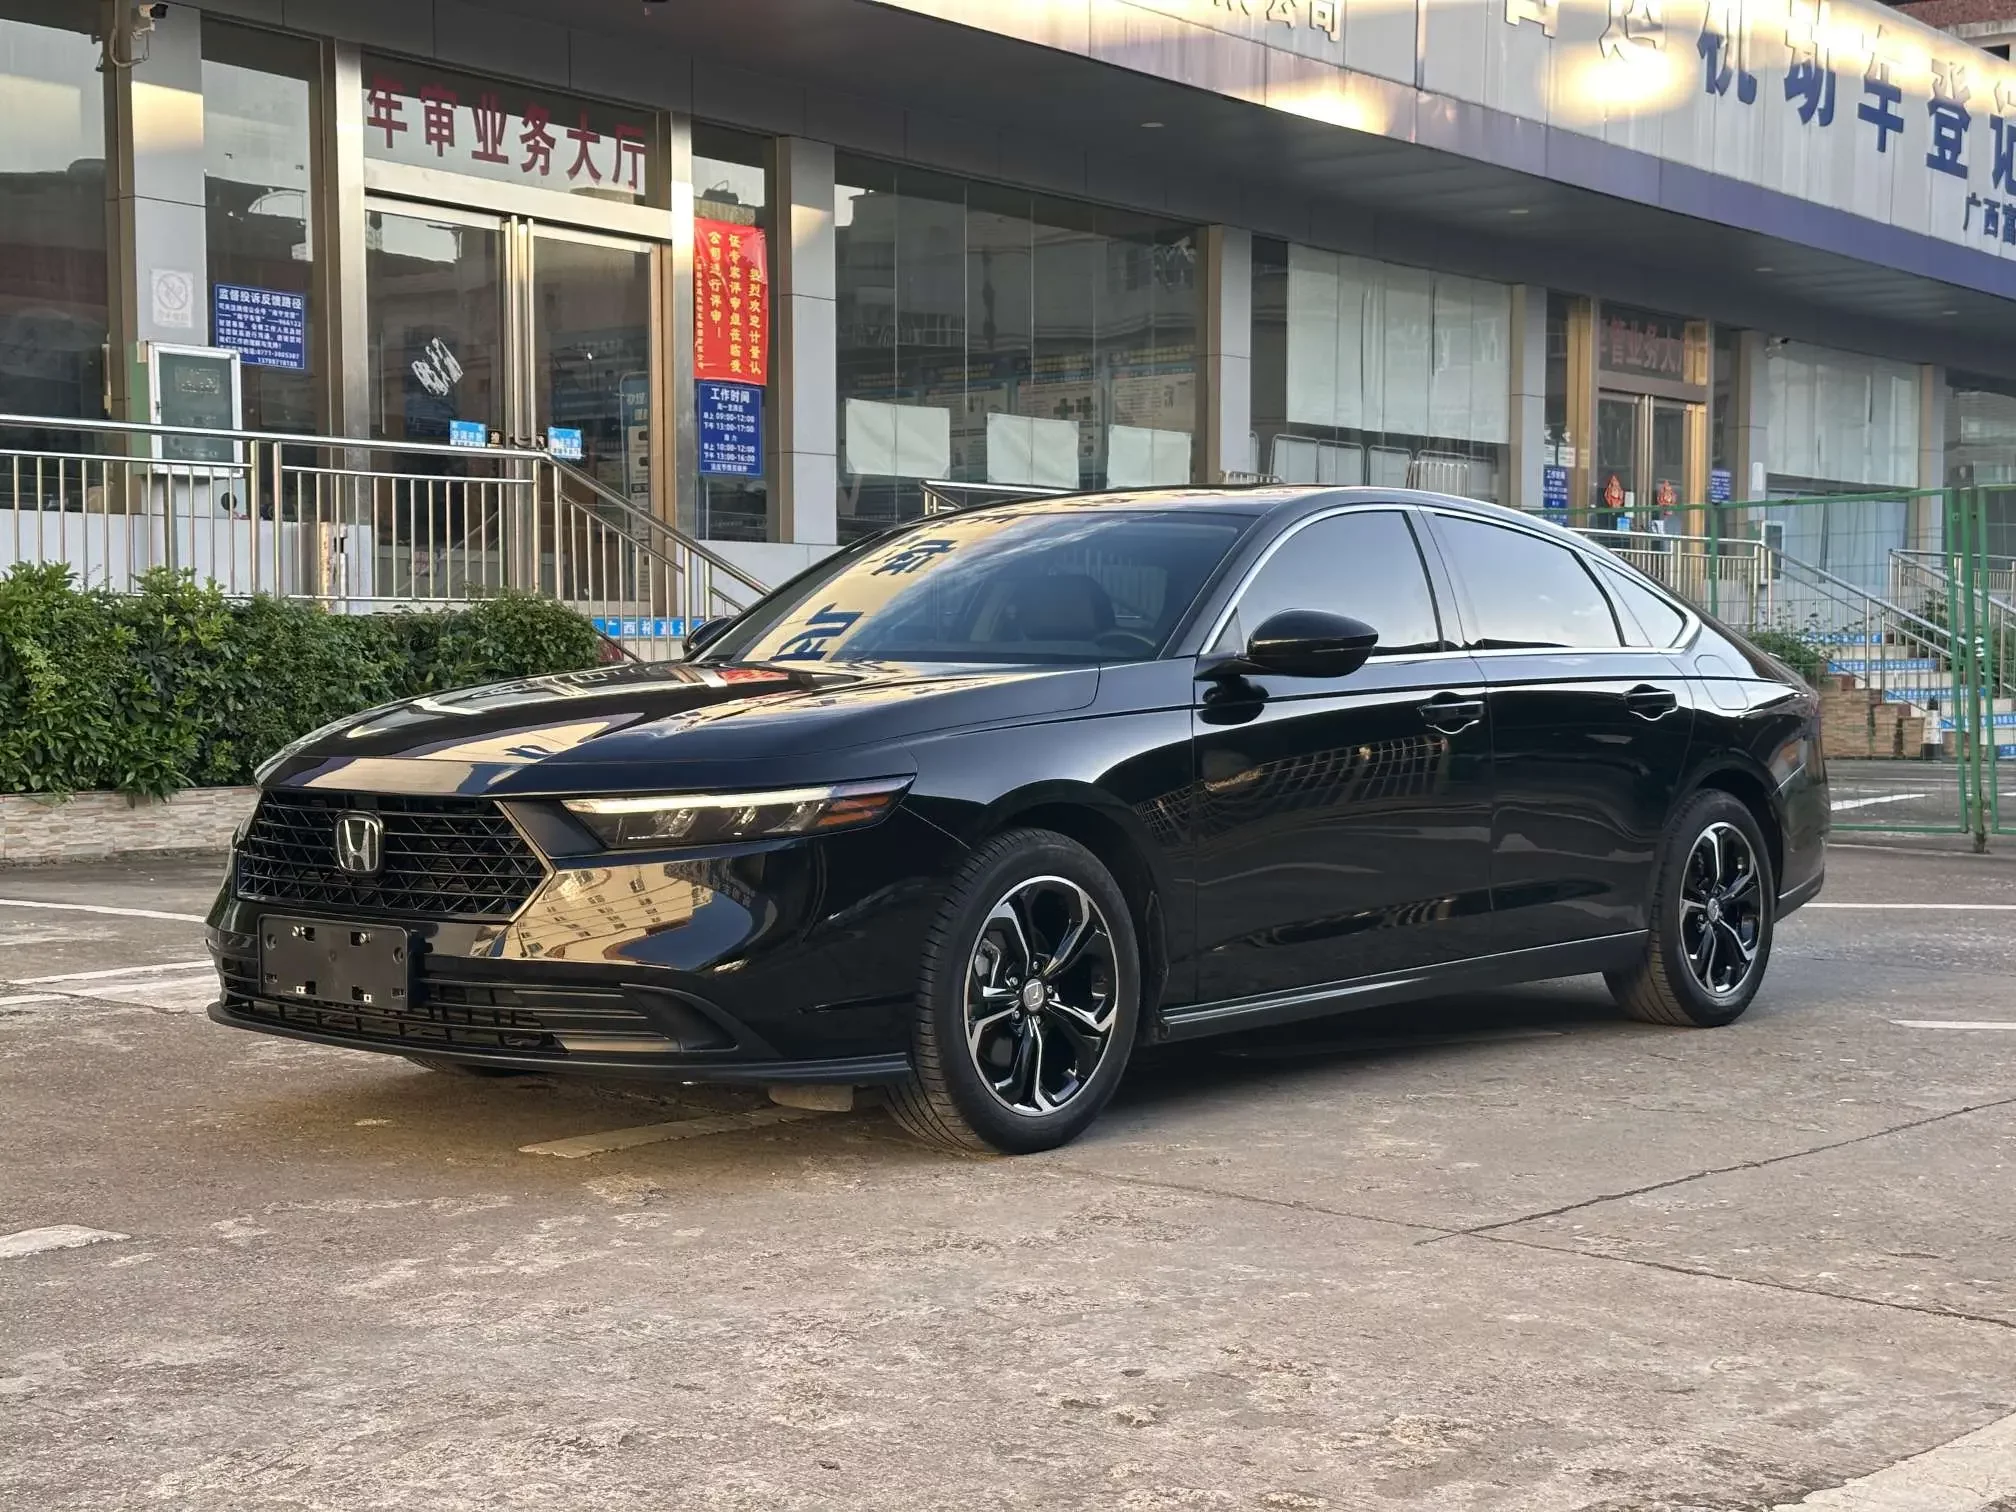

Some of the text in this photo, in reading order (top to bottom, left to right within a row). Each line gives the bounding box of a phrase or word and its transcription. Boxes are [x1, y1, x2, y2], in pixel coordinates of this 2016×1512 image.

[367, 75, 646, 190] 年审业务大厅
[218, 288, 302, 310] 监督投诉反馈路径
[710, 387, 750, 404] 工作时间
